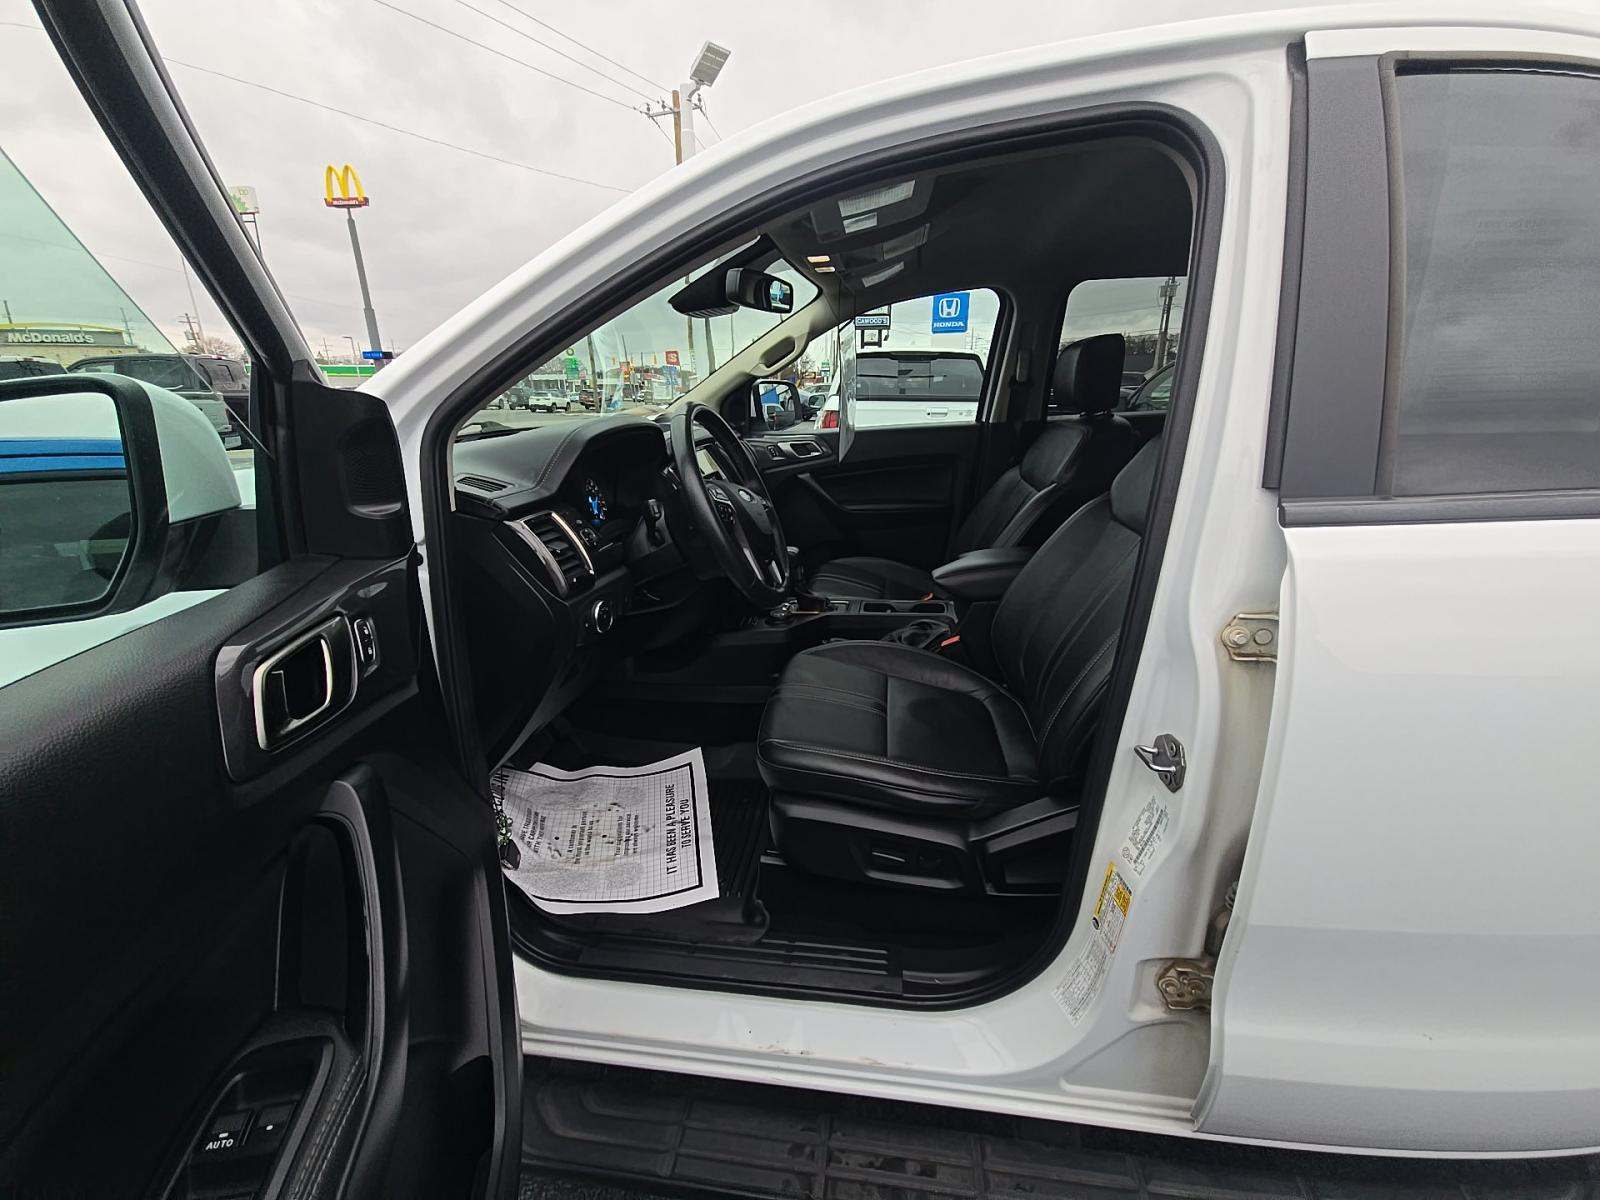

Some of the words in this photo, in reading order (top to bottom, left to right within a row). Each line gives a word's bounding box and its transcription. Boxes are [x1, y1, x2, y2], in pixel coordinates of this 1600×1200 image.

[8, 333, 94, 344] McDonald's
[665, 784, 676, 820] PLEASURE
[679, 799, 690, 815] YOU
[680, 816, 691, 838] SERVE
[666, 828, 677, 847] BEEN
[681, 840, 692, 848] TO
[666, 847, 677, 863] HAS
[666, 866, 677, 874] IT
[205, 1139, 234, 1150] AUTO
